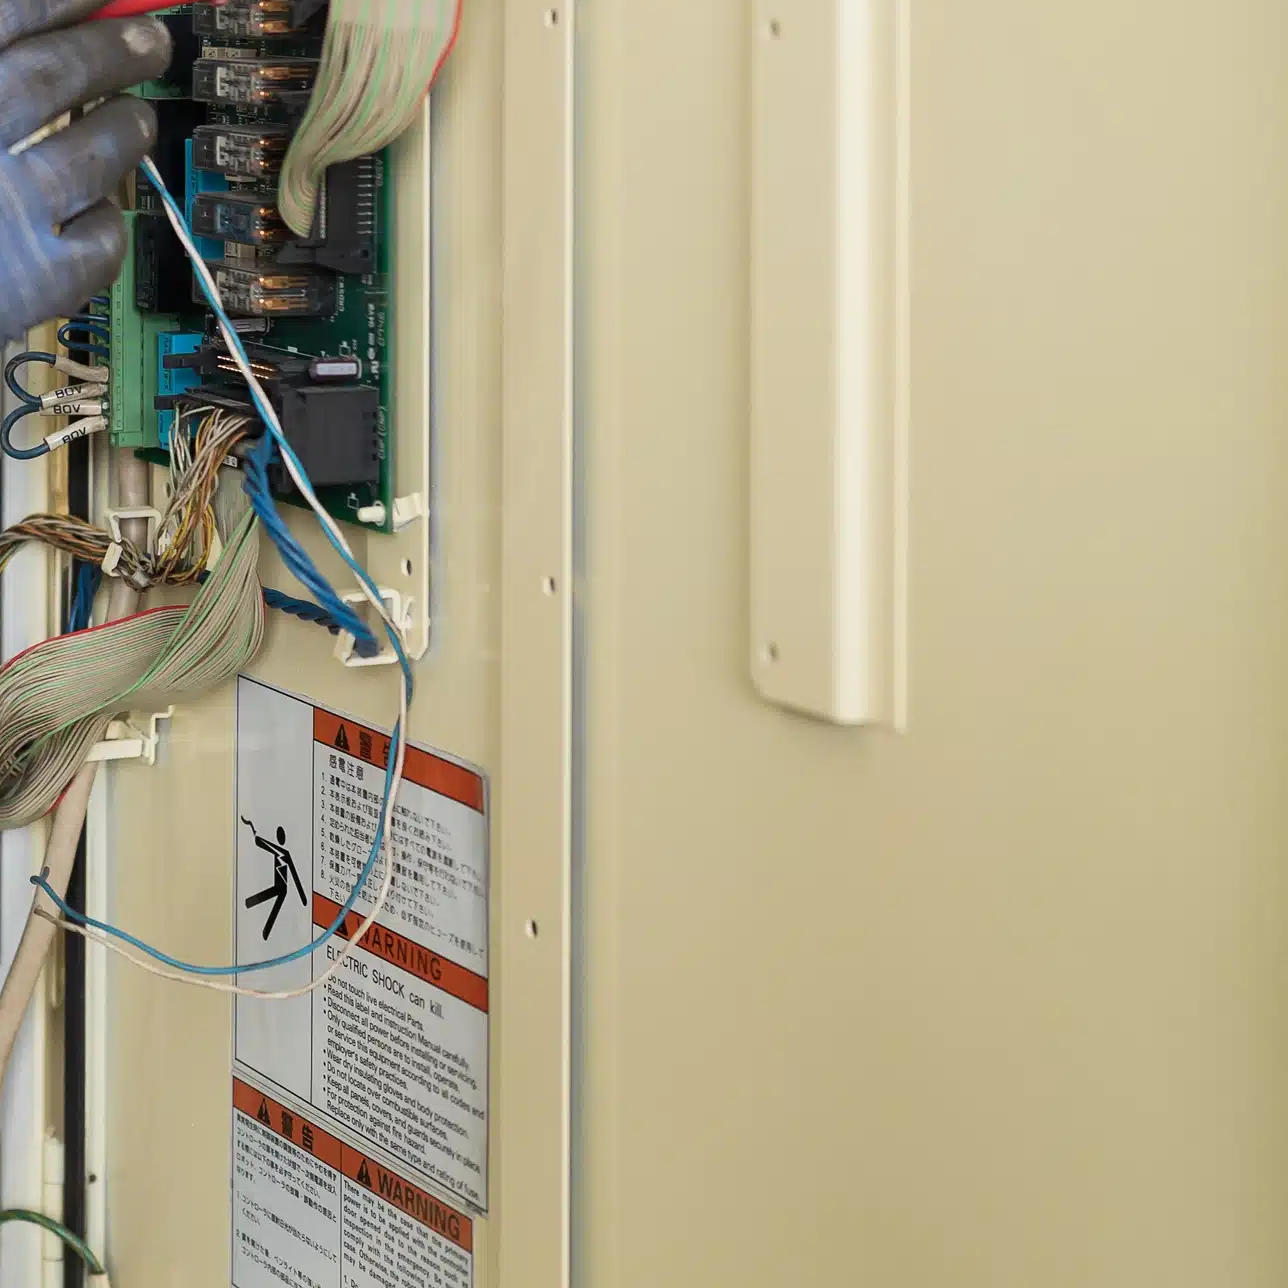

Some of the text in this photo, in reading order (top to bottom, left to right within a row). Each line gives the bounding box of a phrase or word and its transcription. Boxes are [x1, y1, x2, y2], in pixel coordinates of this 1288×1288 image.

[328, 753, 364, 782] 感電注意
[327, 983, 343, 1001] Read
[343, 992, 354, 1007] this
[354, 998, 370, 1016] label
[370, 1007, 383, 1023] and
[383, 1014, 417, 1042] instruction
[417, 1032, 442, 1056] Manual
[337, 976, 348, 991] not
[348, 982, 365, 1000] touch
[365, 991, 378, 1007] live
[378, 998, 406, 1023] electrical
[406, 1013, 424, 1032] Parts.
[371, 967, 405, 999] SHOCK
[409, 990, 425, 1010] can
[429, 998, 444, 1020] kill.
[326, 1009, 341, 1029] Only
[340, 1017, 367, 1043] qualified
[366, 1033, 392, 1058] persons
[392, 1048, 403, 1061] are
[403, 1053, 411, 1066] to
[326, 1024, 440, 1096] or service this equipment according to
[327, 996, 360, 1024] Disconnect
[360, 1015, 369, 1029] all
[369, 1021, 389, 1043] power
[389, 1031, 410, 1052] before
[410, 1042, 439, 1071] installing
[438, 1060, 446, 1072] or
[327, 1034, 408, 1094] employer's safety practices.
[326, 1047, 433, 1122] Wear dry insulating gloves and body
[326, 1060, 448, 1142] Do not locate over combustible surfaces.
[326, 1073, 343, 1094] Keep
[342, 1082, 350, 1096] all
[394, 1113, 407, 1131] and
[407, 1121, 429, 1147] guards
[429, 1134, 455, 1163] securely
[280, 1108, 314, 1153] 警告
[326, 1086, 426, 1156] For protection against fire hazard.
[326, 1098, 456, 1191] Replace only with the same type and rating
[376, 1167, 460, 1243] WARNING
